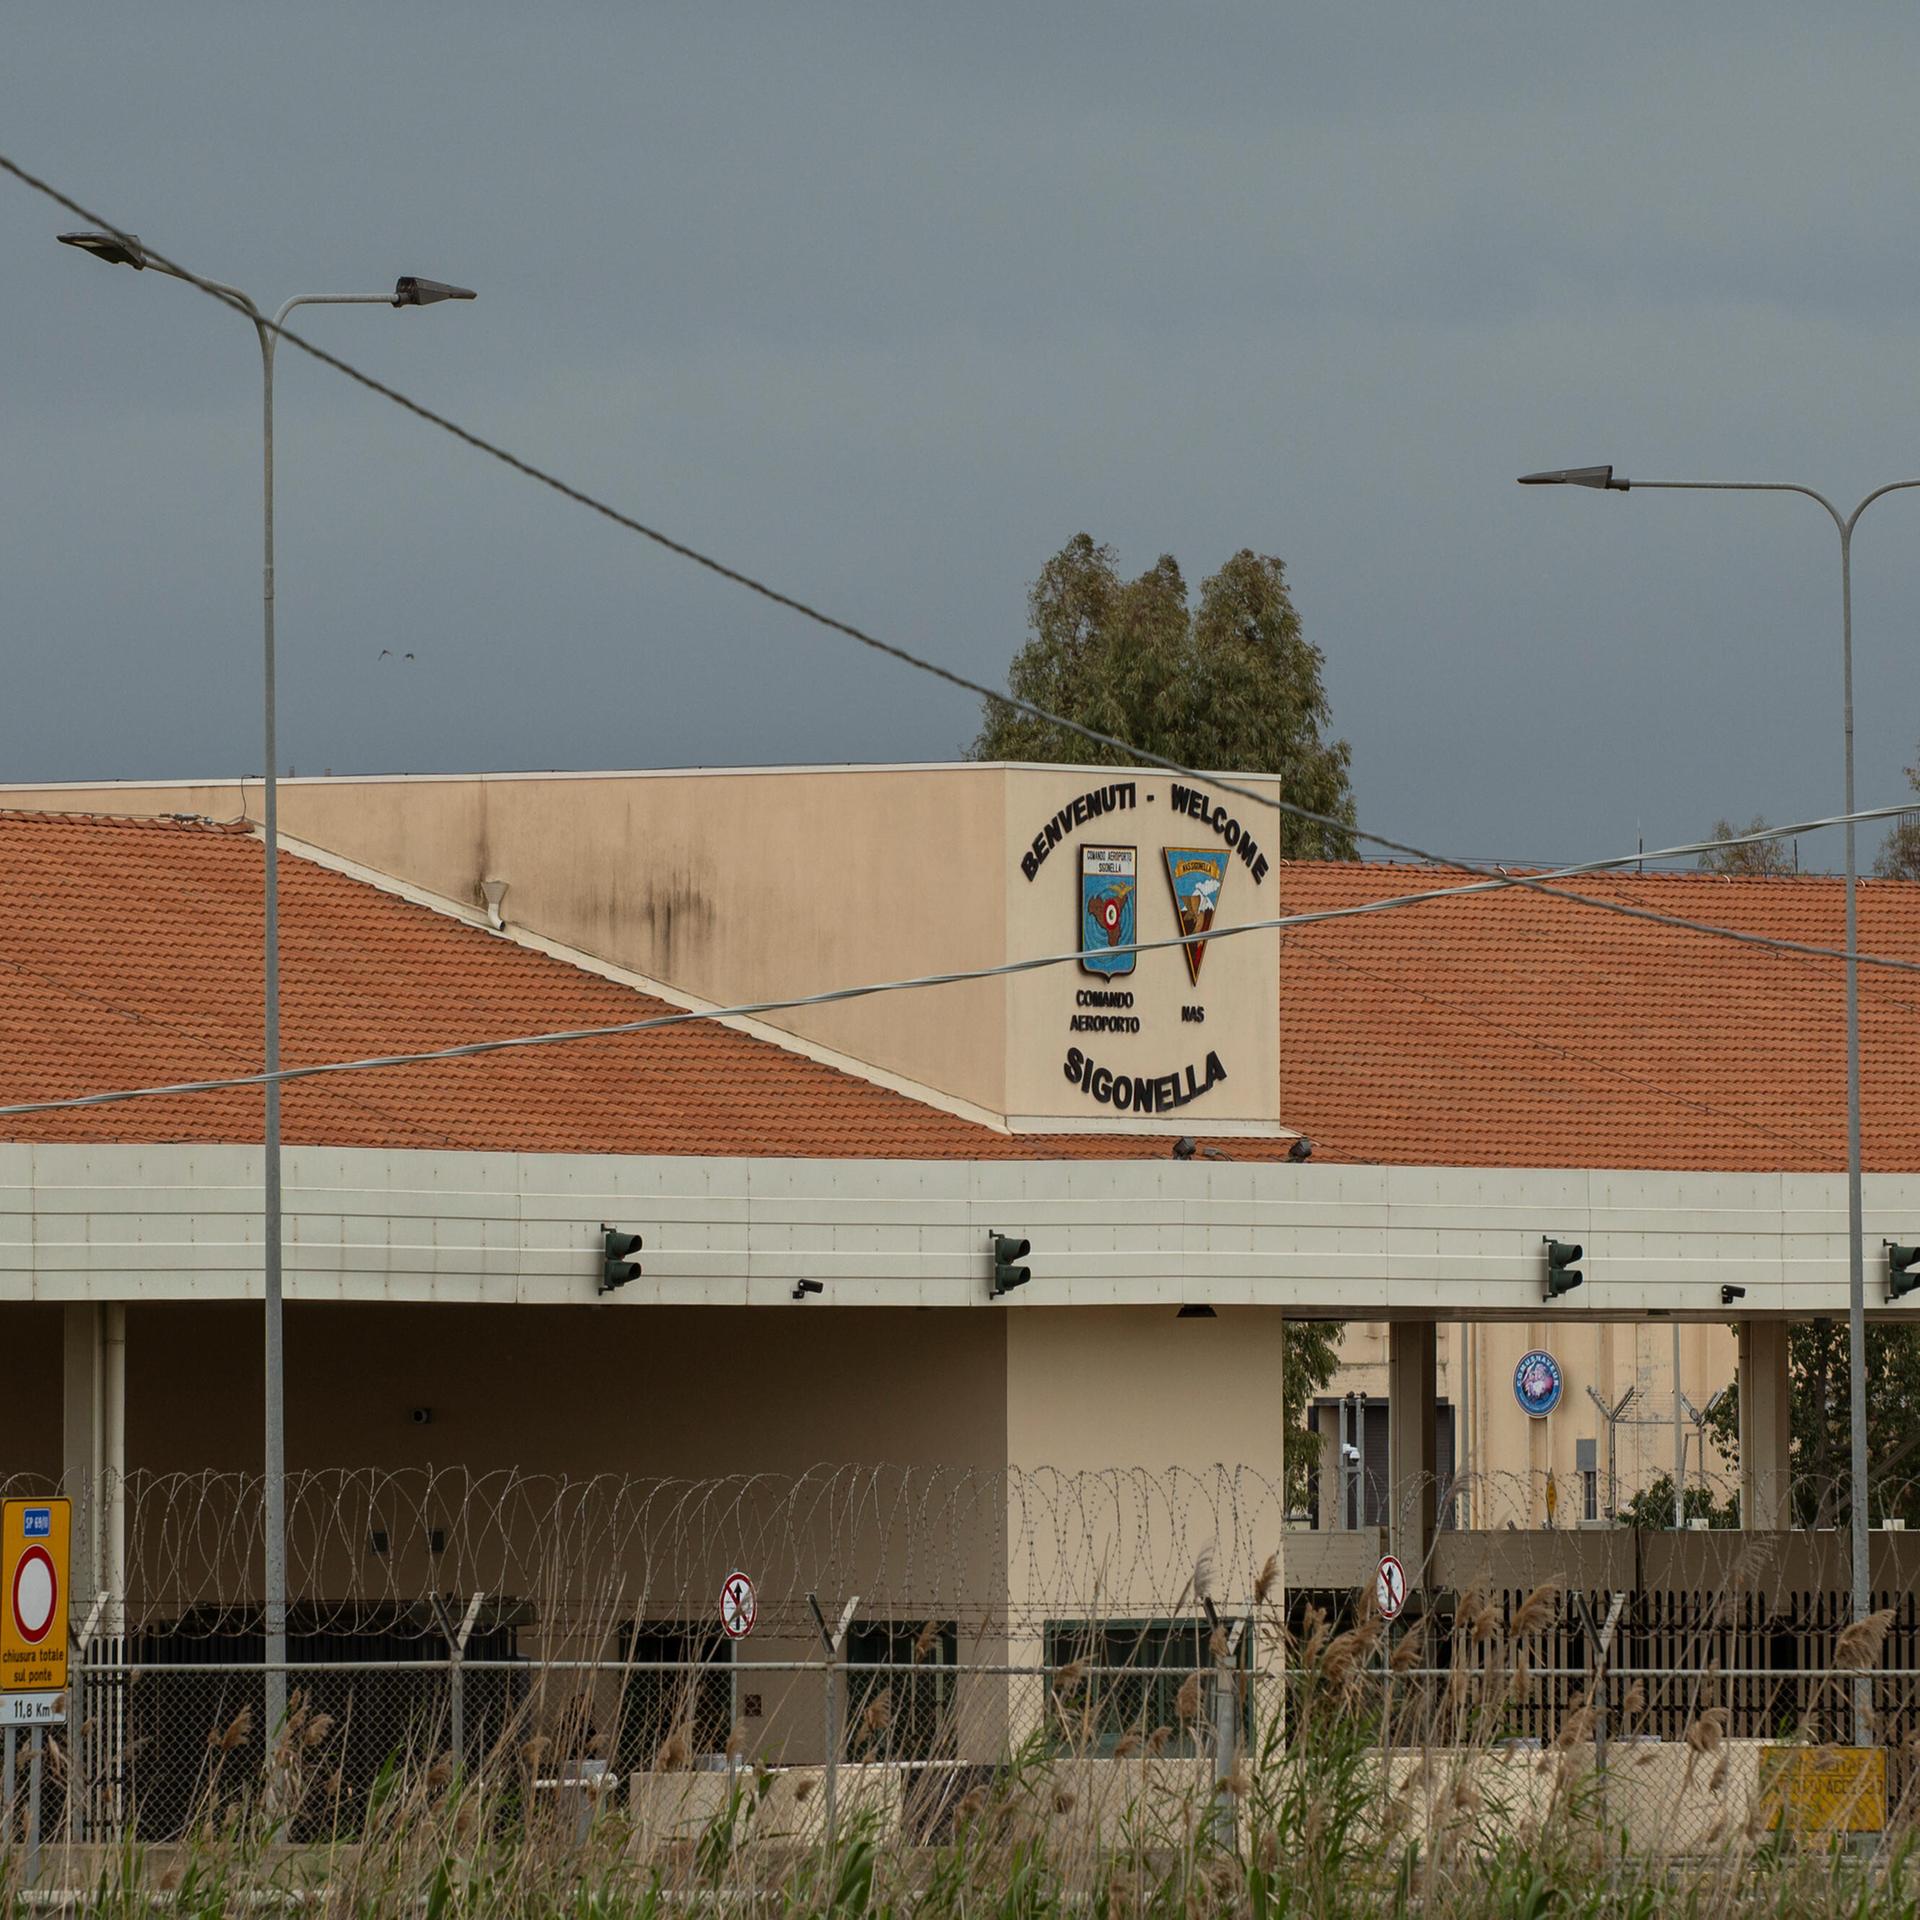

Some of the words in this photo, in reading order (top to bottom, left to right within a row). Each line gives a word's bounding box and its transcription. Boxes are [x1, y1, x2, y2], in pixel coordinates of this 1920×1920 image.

[1021, 782, 1136, 882] BENVENUTI
[1171, 783, 1269, 885] WELCOME
[1076, 990, 1134, 1008] COMANDO
[1181, 1006, 1205, 1022] NAS
[1070, 1015, 1140, 1033] AEROPORTO
[1064, 1047, 1227, 1113] SIGONELLA
[3, 1649, 36, 1663] chiusura
[39, 1648, 64, 1661] totale
[14, 1668, 26, 1682] sul
[28, 1668, 52, 1684] ponte
[14, 1700, 33, 1719] 11,8
[36, 1702, 50, 1717] Km
